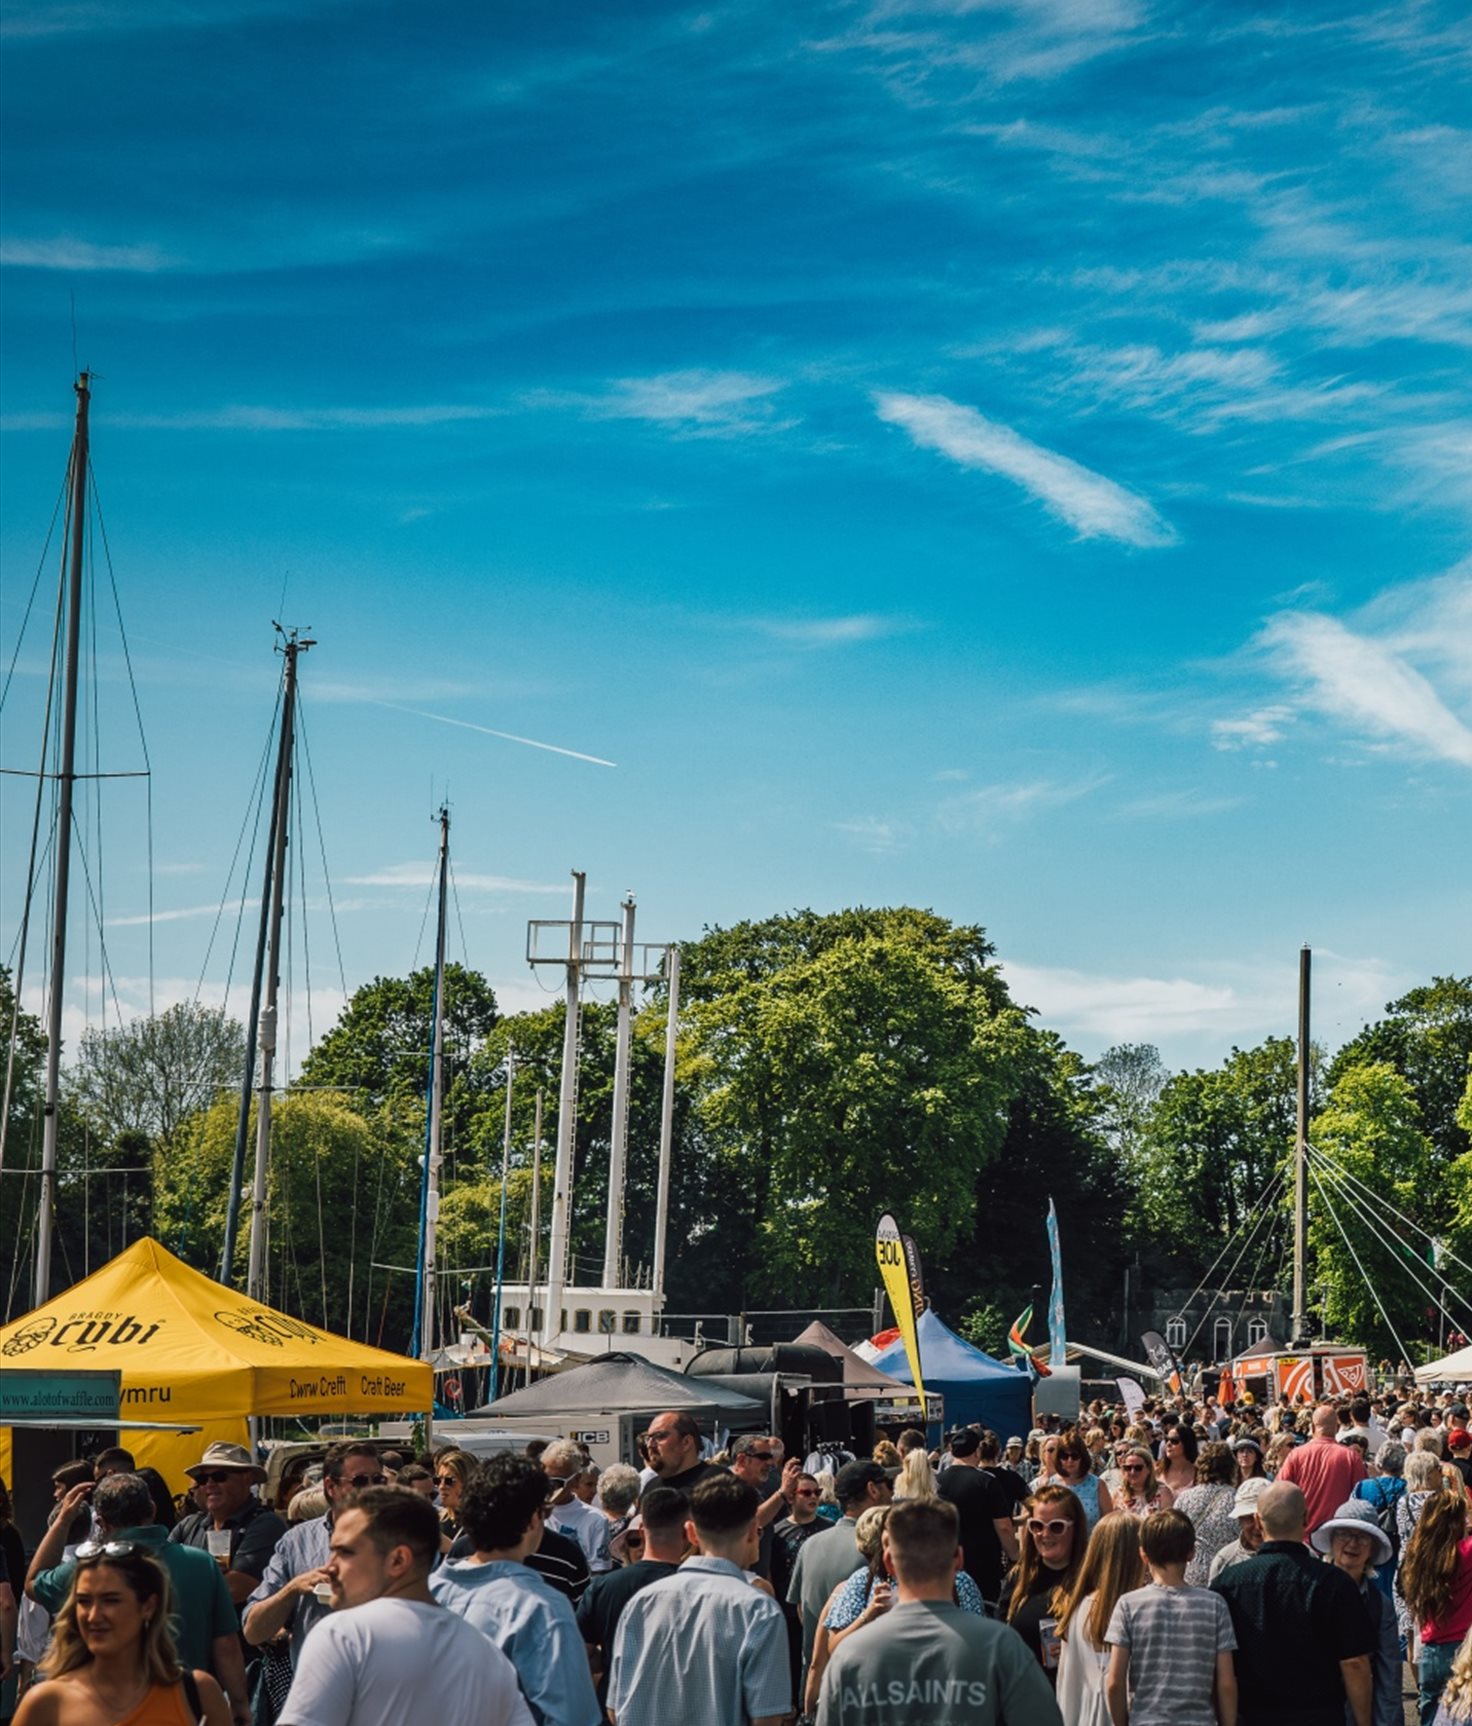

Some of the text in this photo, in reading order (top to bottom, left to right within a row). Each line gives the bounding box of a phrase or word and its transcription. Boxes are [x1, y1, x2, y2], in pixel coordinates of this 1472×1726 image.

[68, 1311, 123, 1321] BRAGDY
[289, 1375, 406, 1398] Cwrw Crefft Craft Beer
[2, 1390, 115, 1407] www.alotofwaffle.com
[841, 1679, 987, 1712] ALLSAINTS
